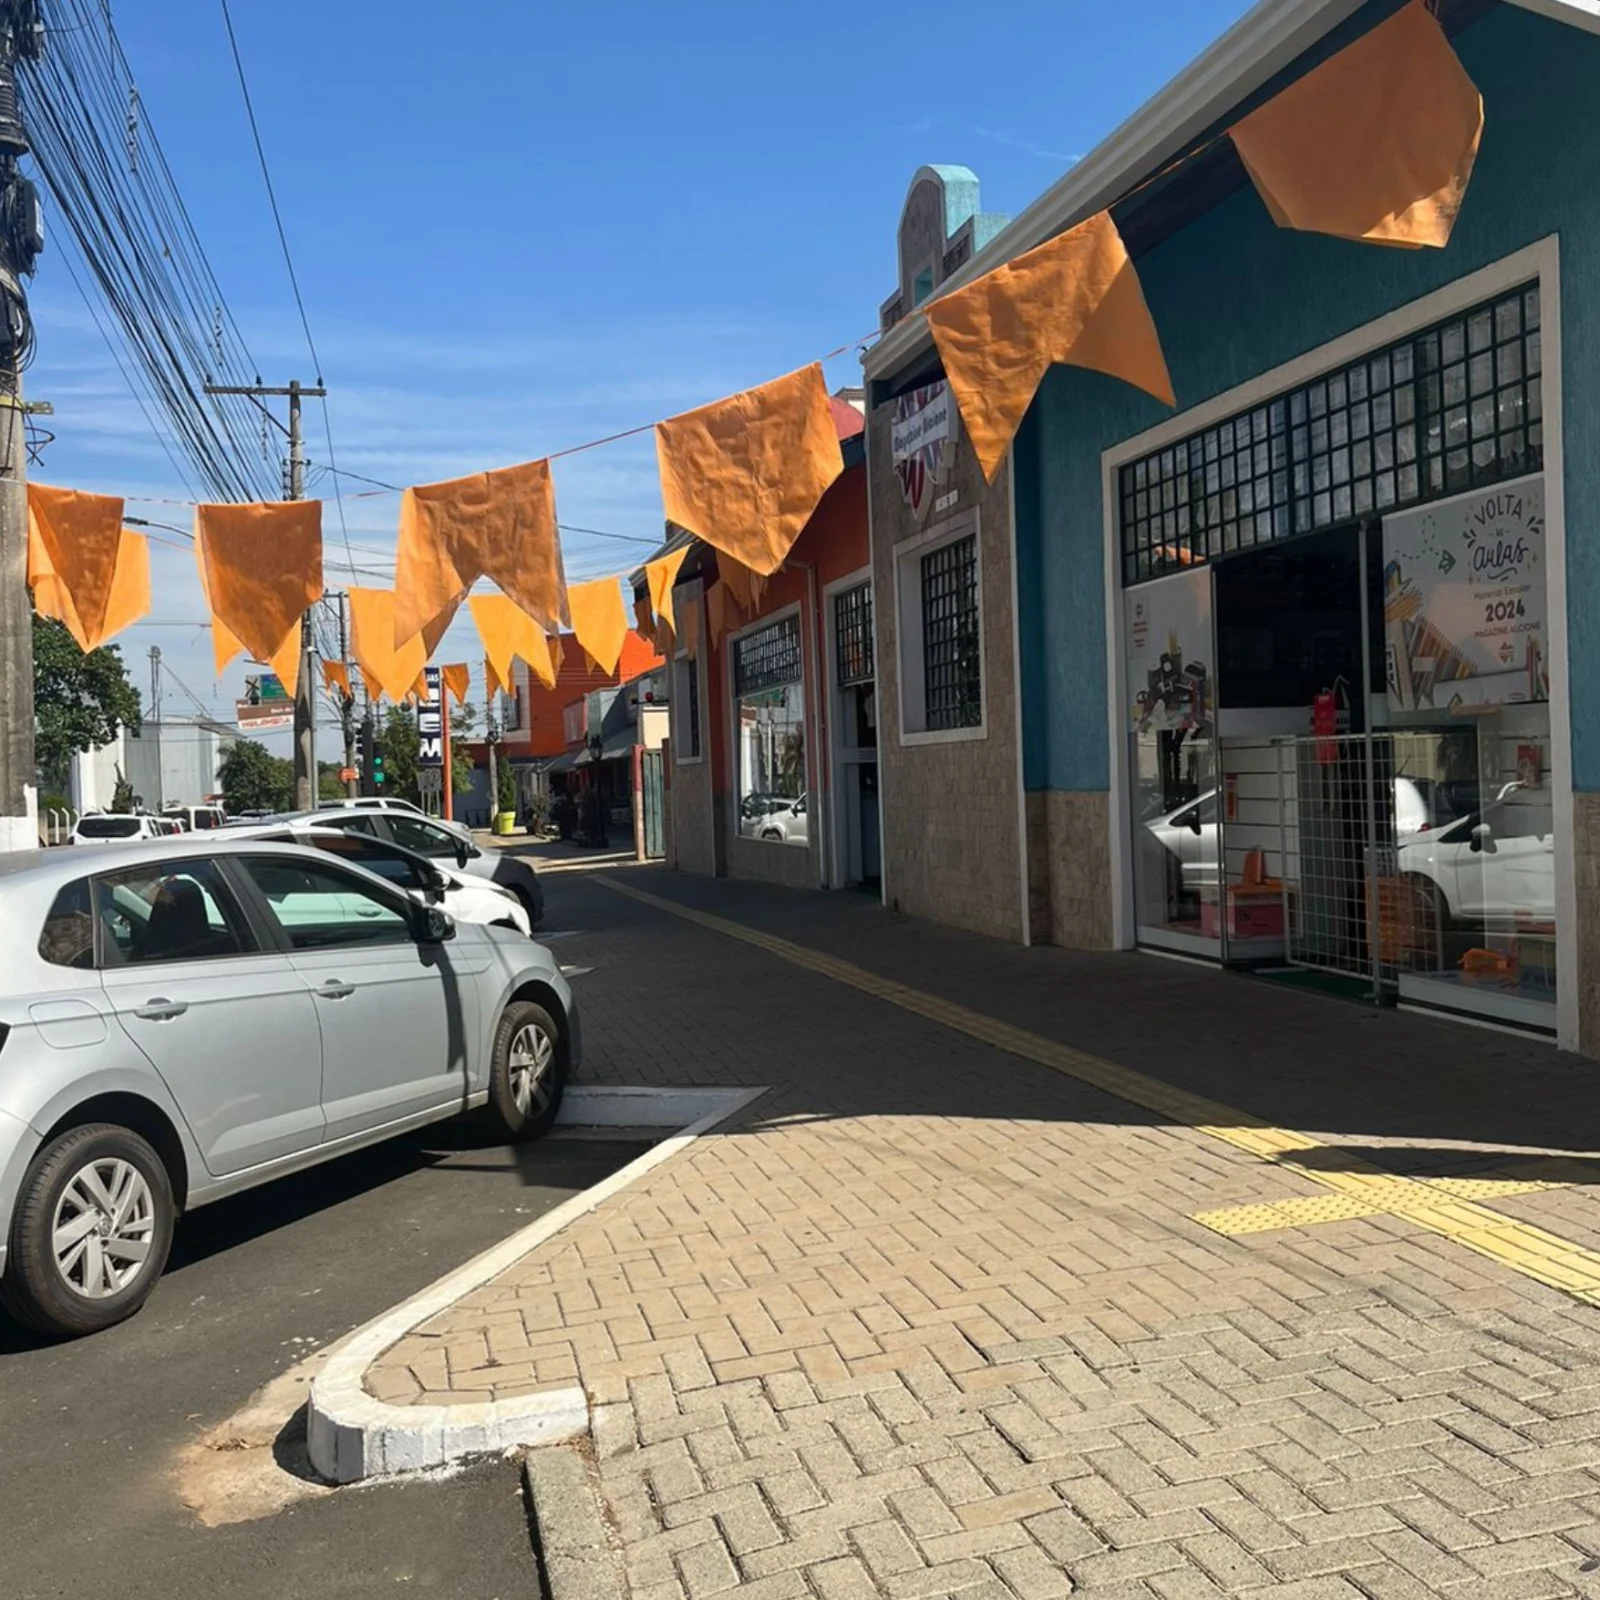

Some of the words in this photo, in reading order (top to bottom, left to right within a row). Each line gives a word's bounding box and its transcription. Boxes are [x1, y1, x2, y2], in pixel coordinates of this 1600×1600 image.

[1474, 494, 1522, 525] VOLTA
[1473, 537, 1529, 571] aulas
[1485, 598, 1526, 622] 2024
